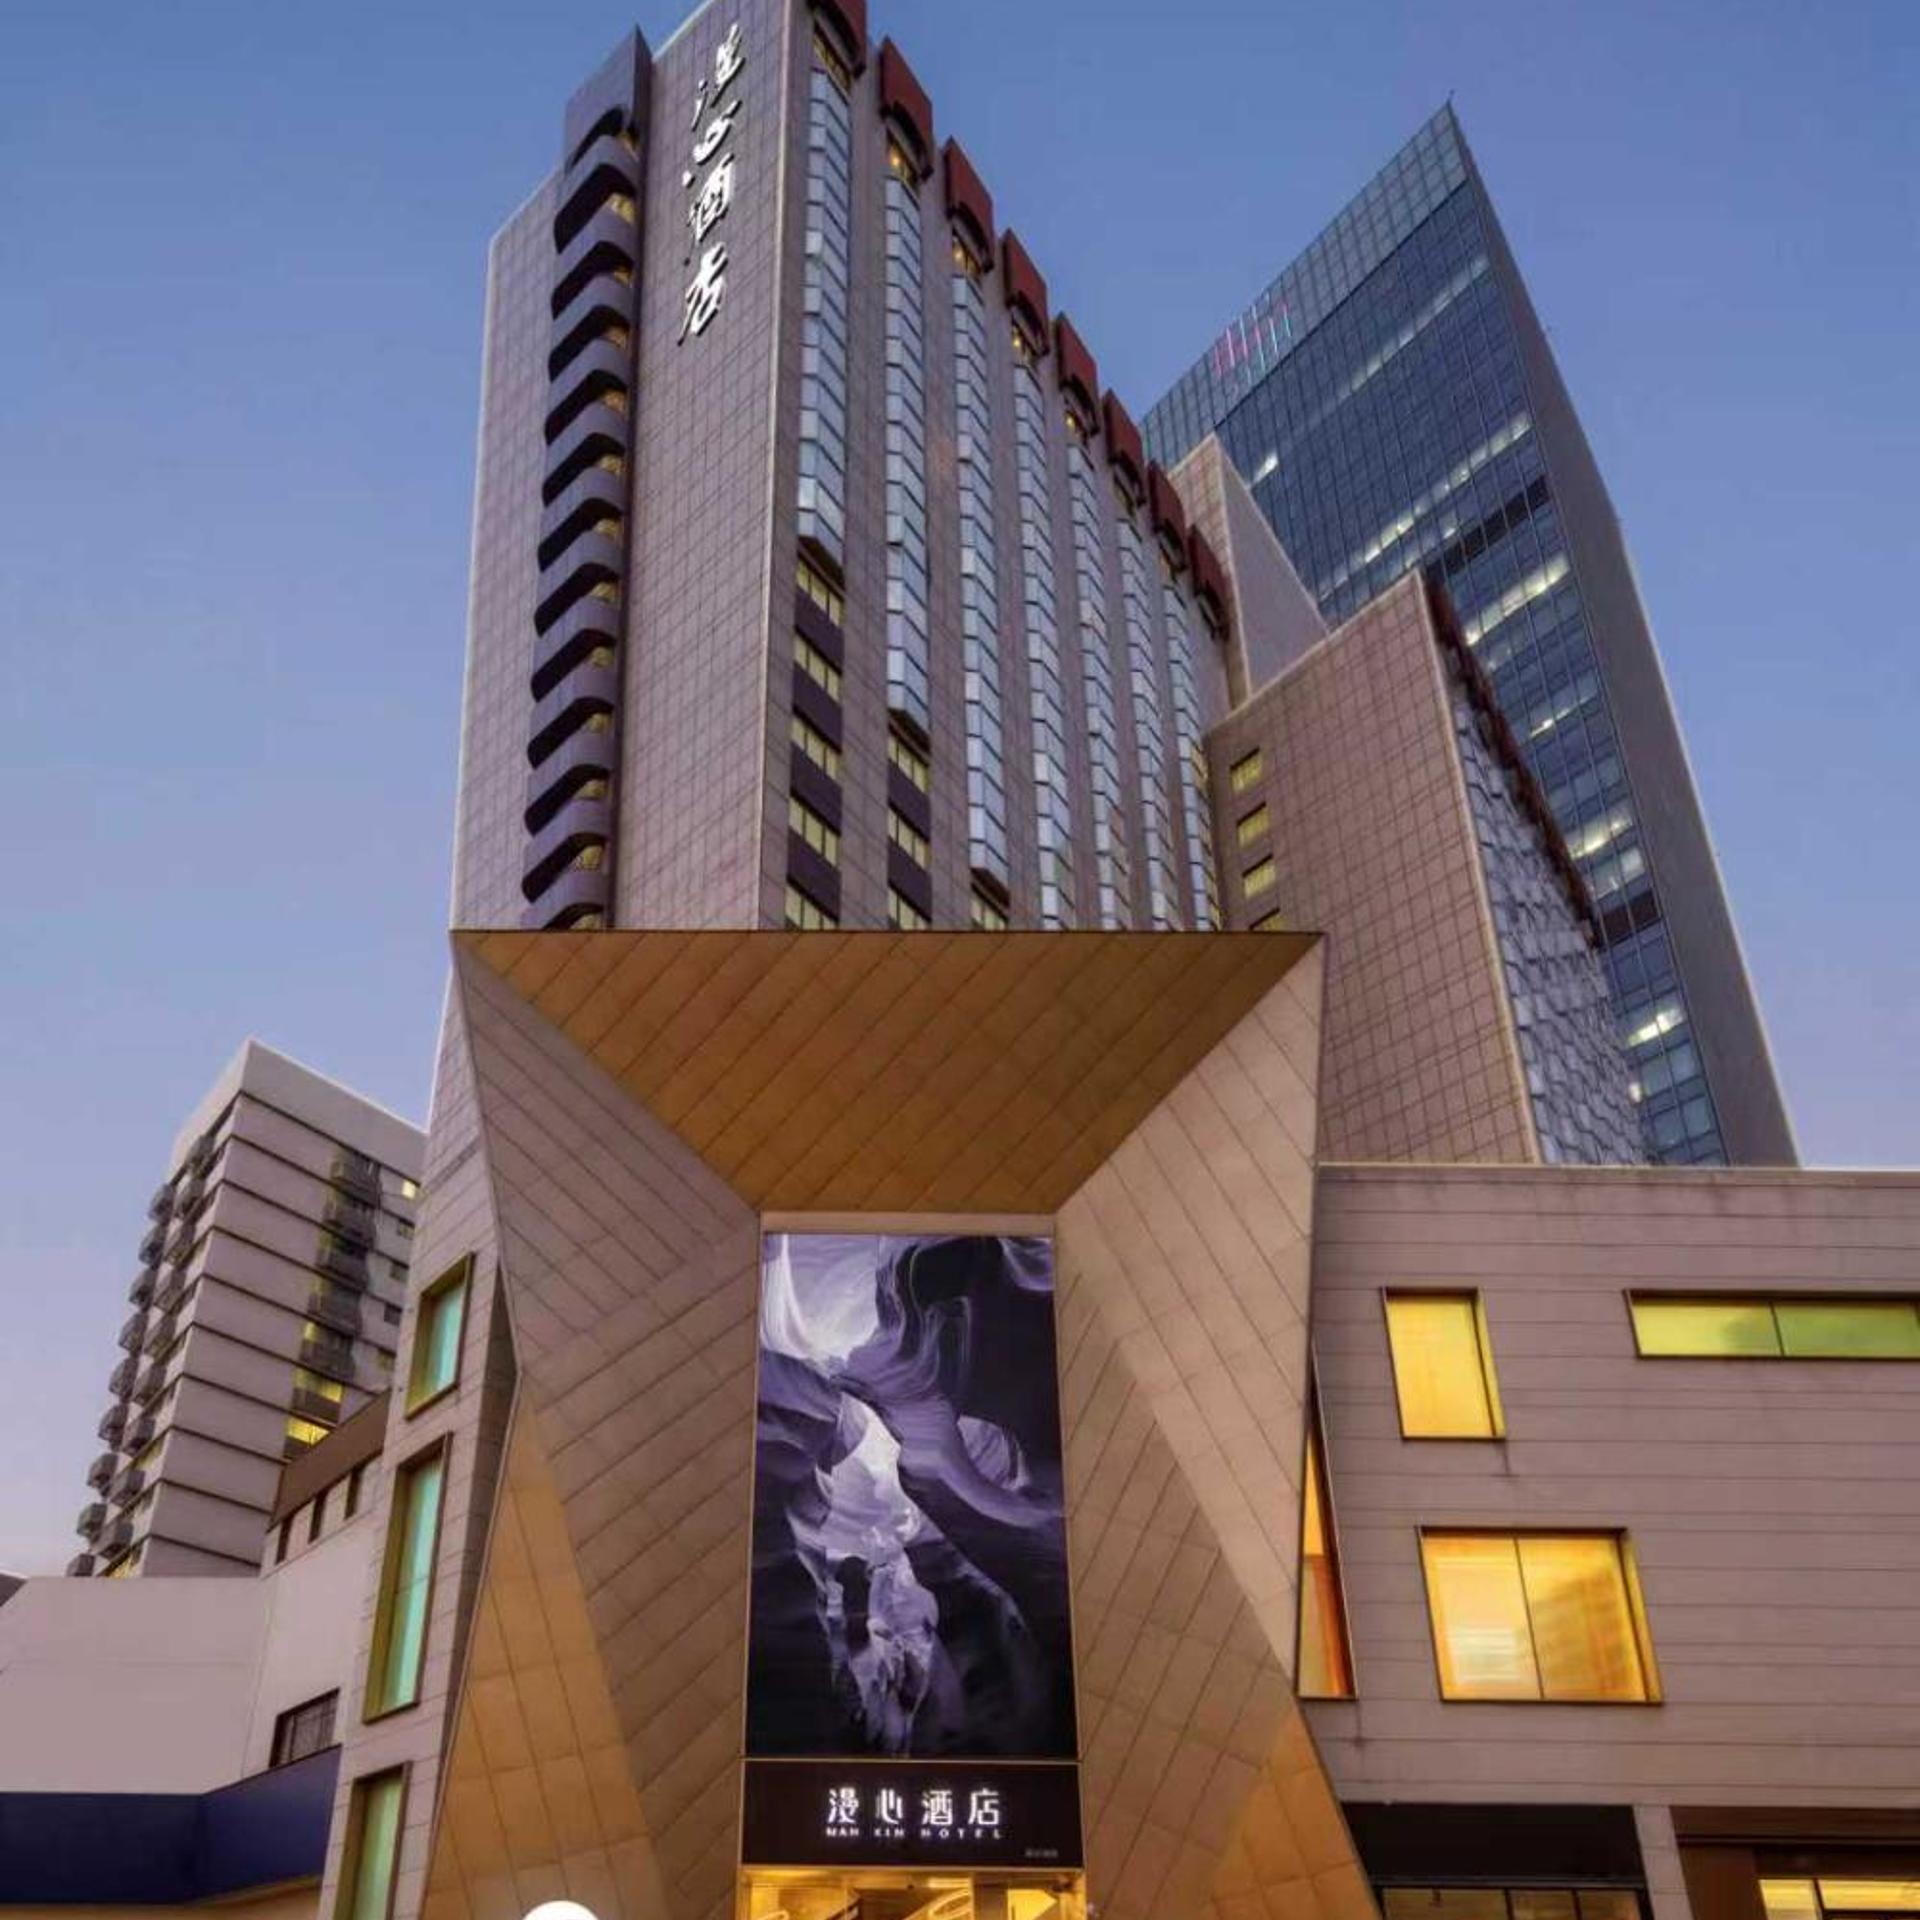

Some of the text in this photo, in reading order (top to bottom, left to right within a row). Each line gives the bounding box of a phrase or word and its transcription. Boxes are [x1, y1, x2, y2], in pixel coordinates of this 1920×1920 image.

[678, 22, 744, 345] 漫心酒店
[826, 1786, 1001, 1826] 漫心酒店
[825, 1827, 860, 1838] MAN
[920, 1827, 1003, 1840] HOTEL
